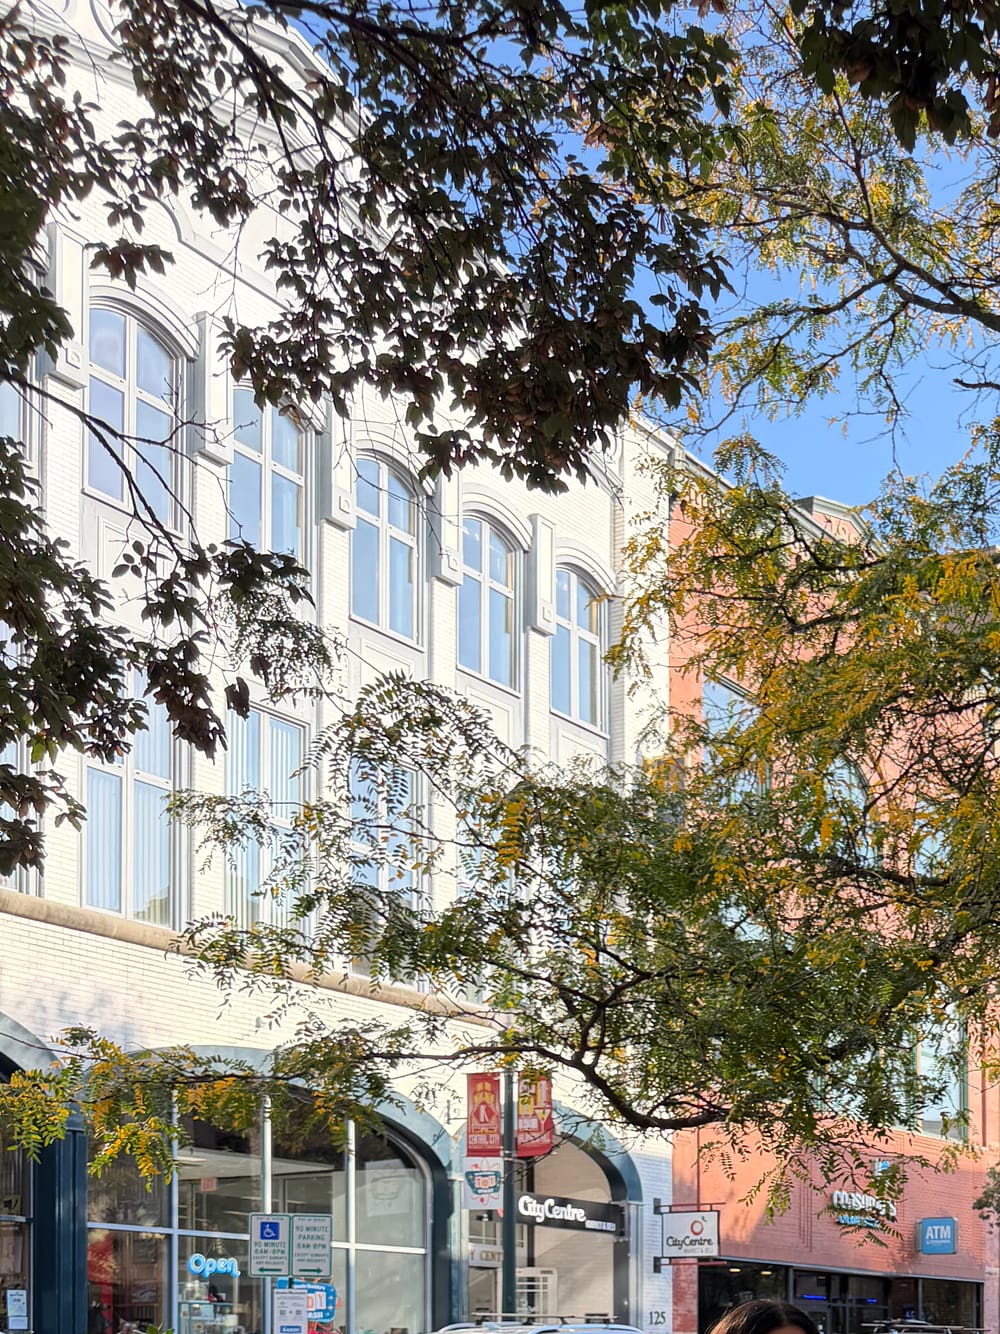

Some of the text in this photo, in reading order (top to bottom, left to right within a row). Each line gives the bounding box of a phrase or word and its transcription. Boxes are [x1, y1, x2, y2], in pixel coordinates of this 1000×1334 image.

[926, 1225, 951, 1239] ATM
[187, 1253, 241, 1278] Open
[649, 1311, 666, 1325] 125
